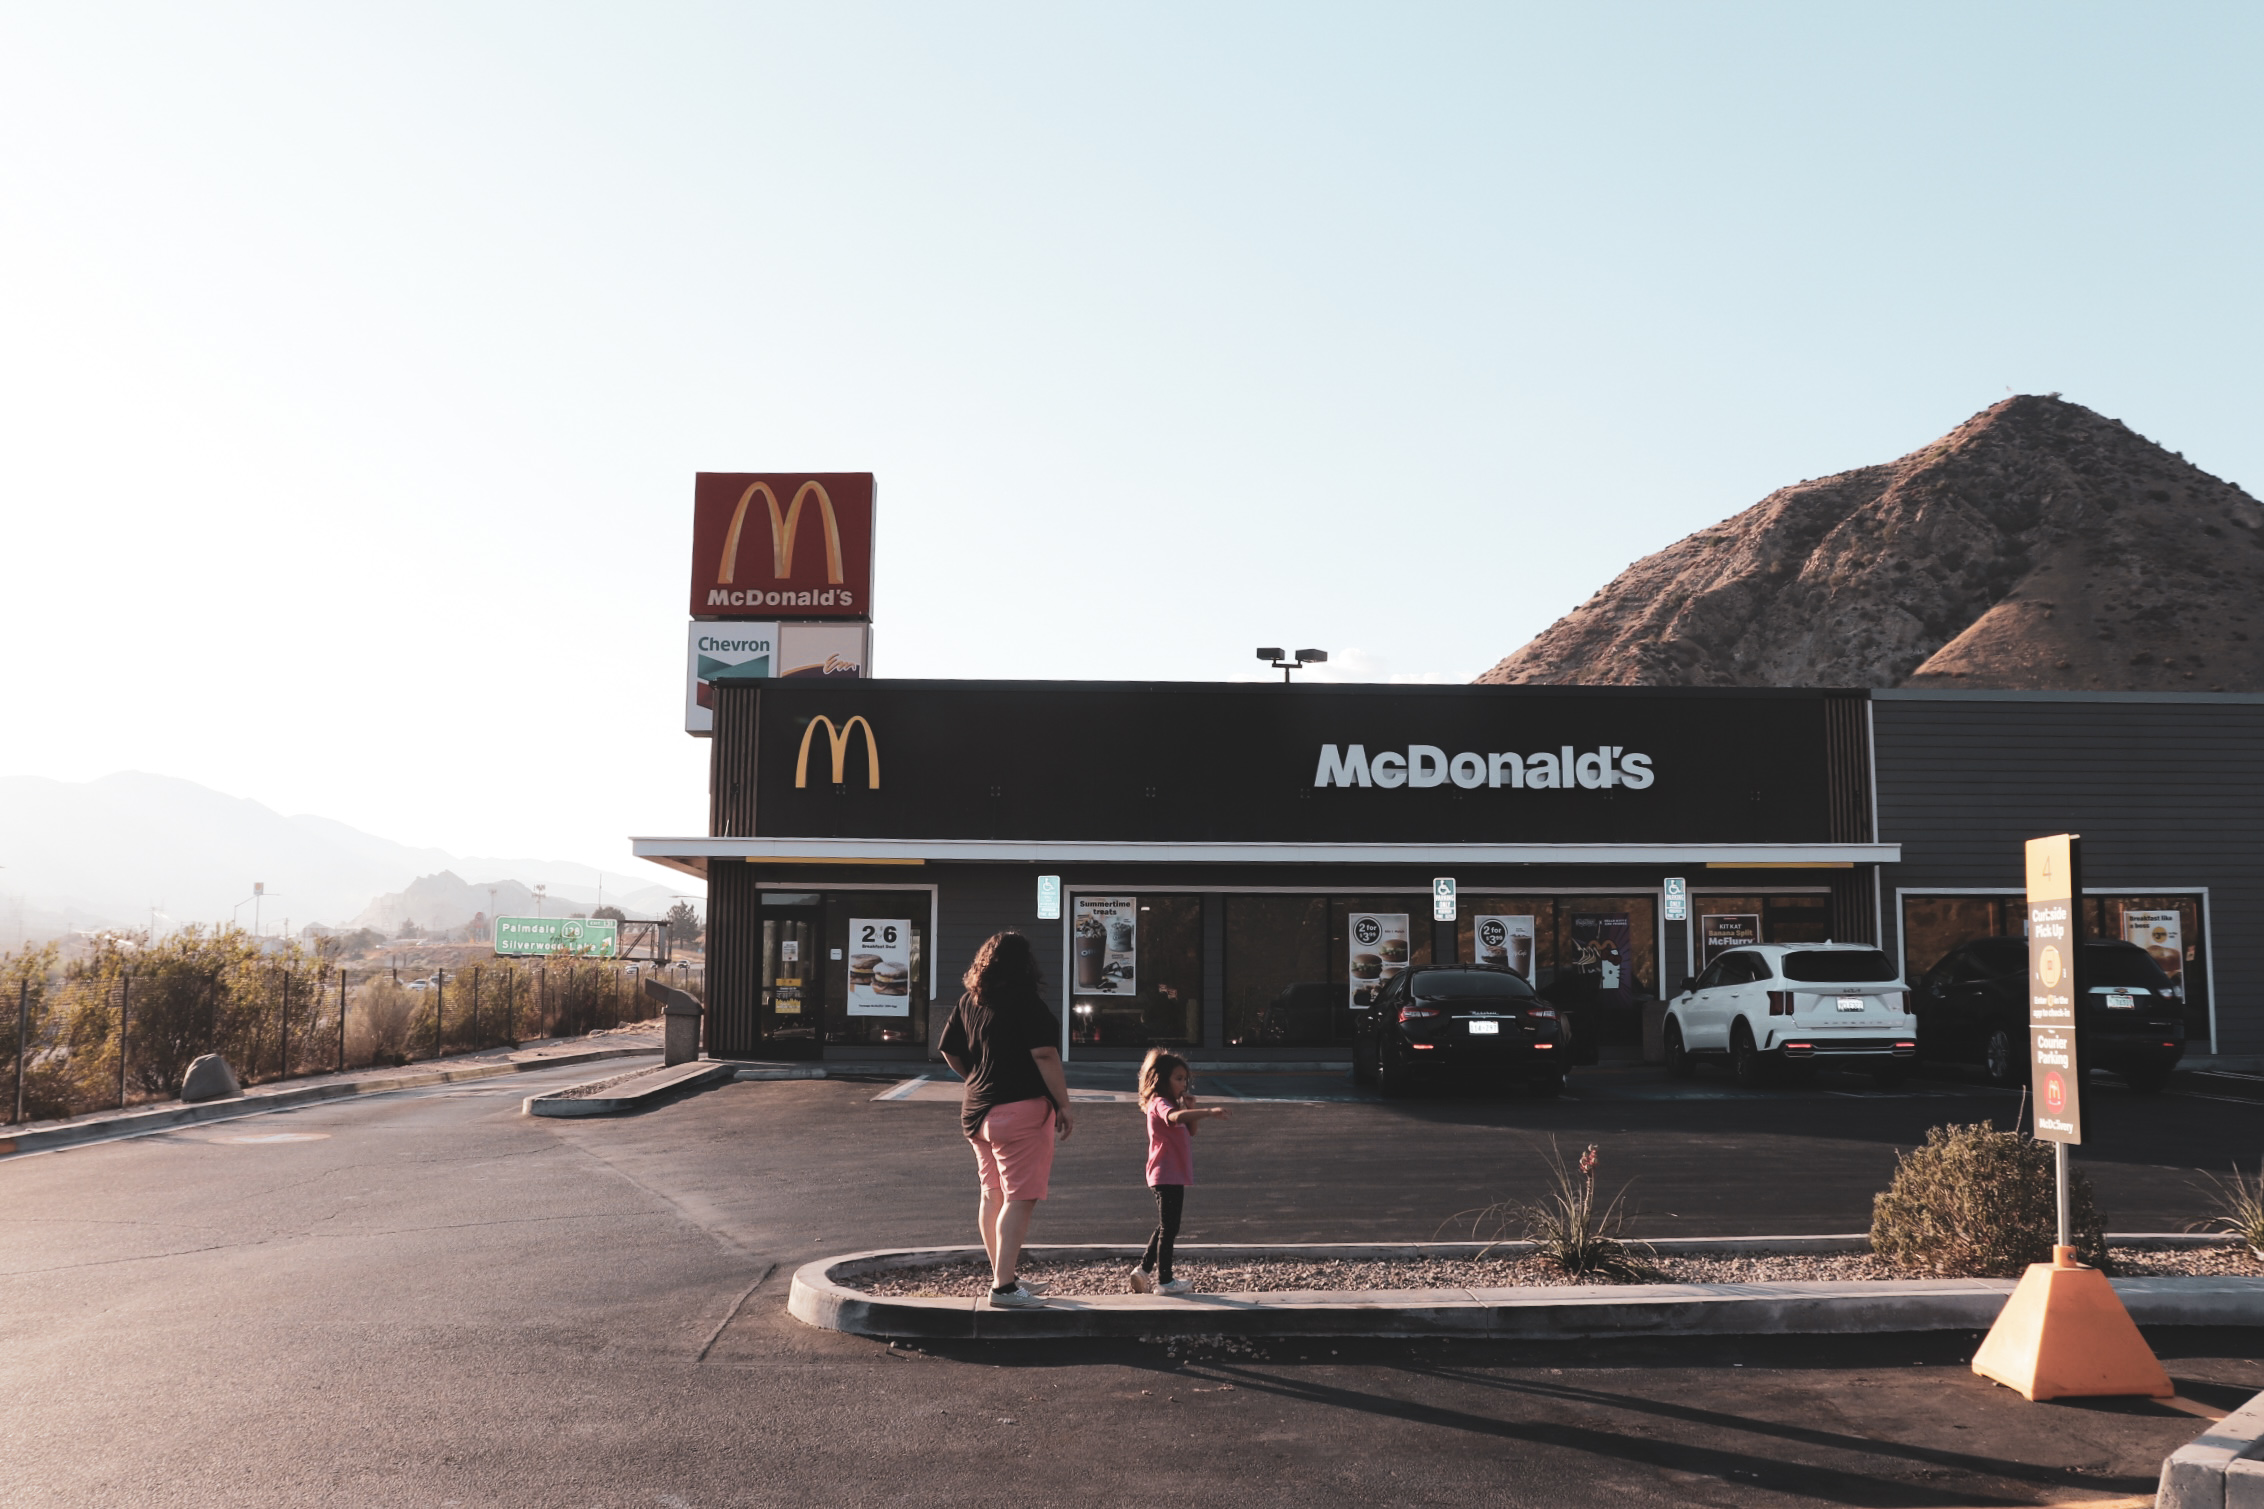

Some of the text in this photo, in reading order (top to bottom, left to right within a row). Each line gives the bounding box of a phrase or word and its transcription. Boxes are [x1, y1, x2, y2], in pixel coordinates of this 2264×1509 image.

[707, 589, 853, 606] McDonald's
[698, 637, 770, 651] Chevron
[1314, 744, 1655, 789] McDonald's
[2042, 856, 2052, 881] 4
[1080, 900, 1131, 908] Summertime
[2032, 907, 2067, 922] Curbside
[502, 924, 556, 934] Palmdale
[862, 925, 876, 943] 2
[1358, 922, 1366, 932] 2
[1483, 925, 1491, 935] 2
[1736, 929, 1753, 937] Split
[2035, 924, 2064, 939] Pick Up
[502, 940, 597, 951] Silverwood Lake
[1708, 937, 1753, 946] McFlurry
[2037, 1034, 2068, 1050] Courier
[2037, 1051, 2069, 1069] Parking
[2039, 1118, 2073, 1134] McDelivery
